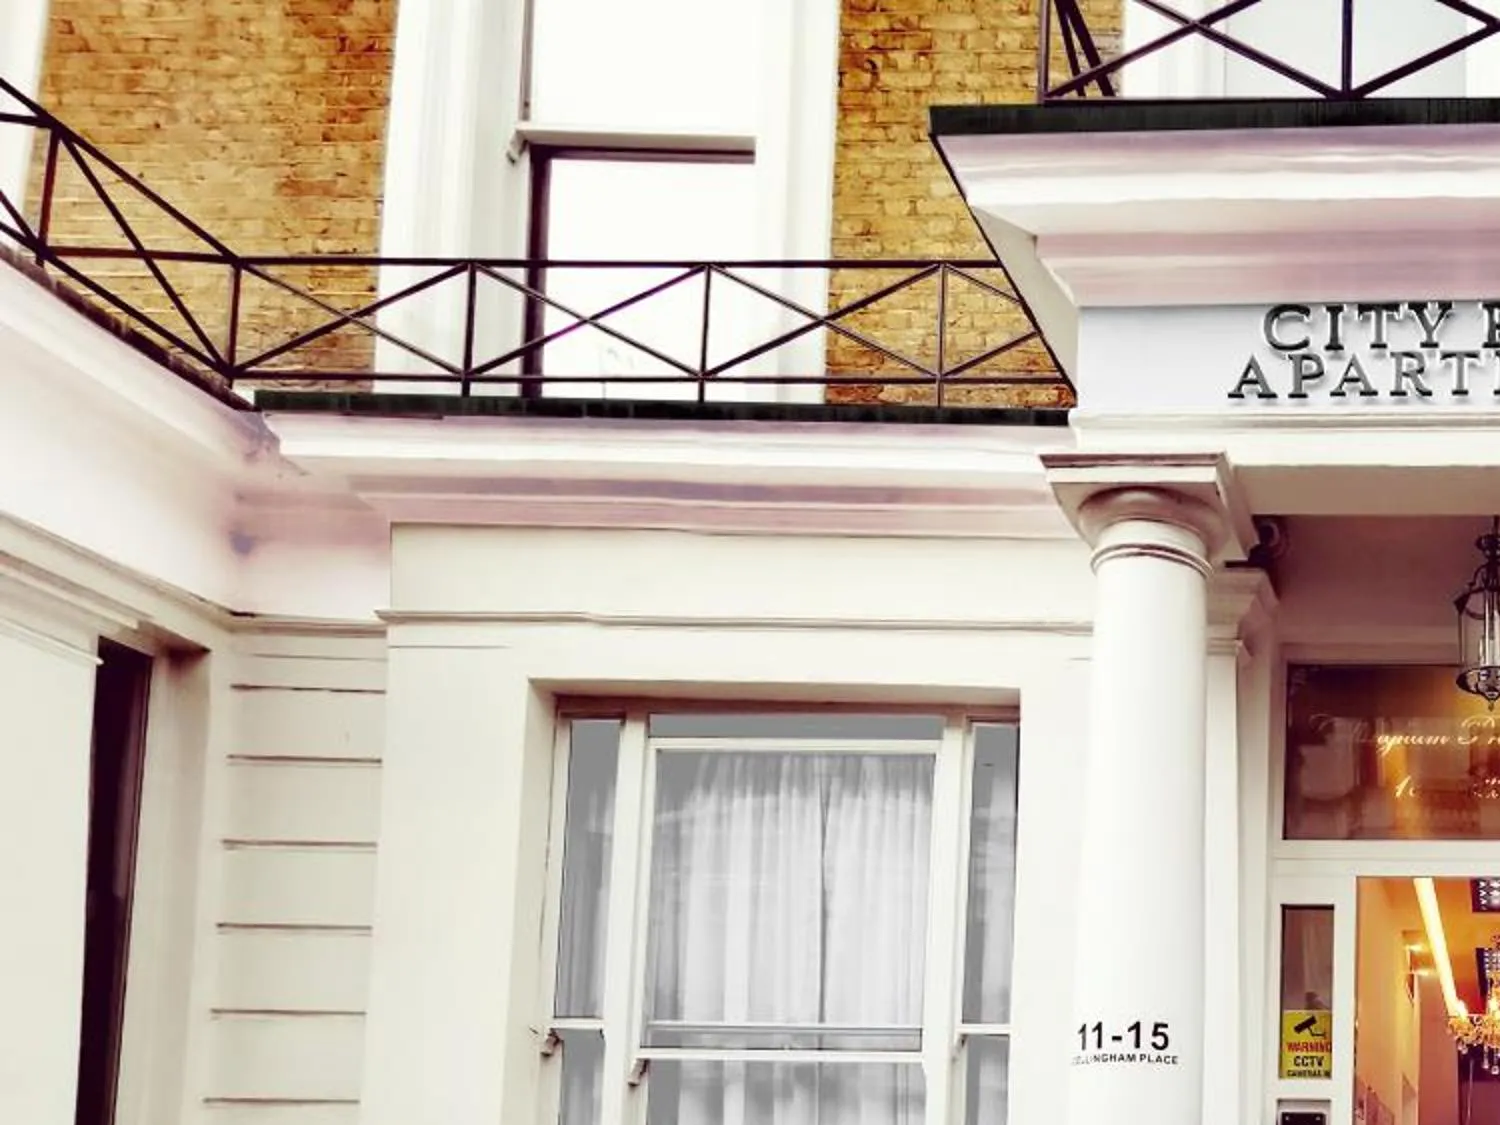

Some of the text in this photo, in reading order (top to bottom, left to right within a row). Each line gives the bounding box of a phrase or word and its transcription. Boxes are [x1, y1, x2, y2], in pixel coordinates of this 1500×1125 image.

[1263, 300, 1453, 352] CITY
[1078, 1020, 1170, 1051] 11-15
[1070, 1052, 1179, 1065] LINGHAM PLACE
[1293, 1055, 1325, 1068] CCTV
